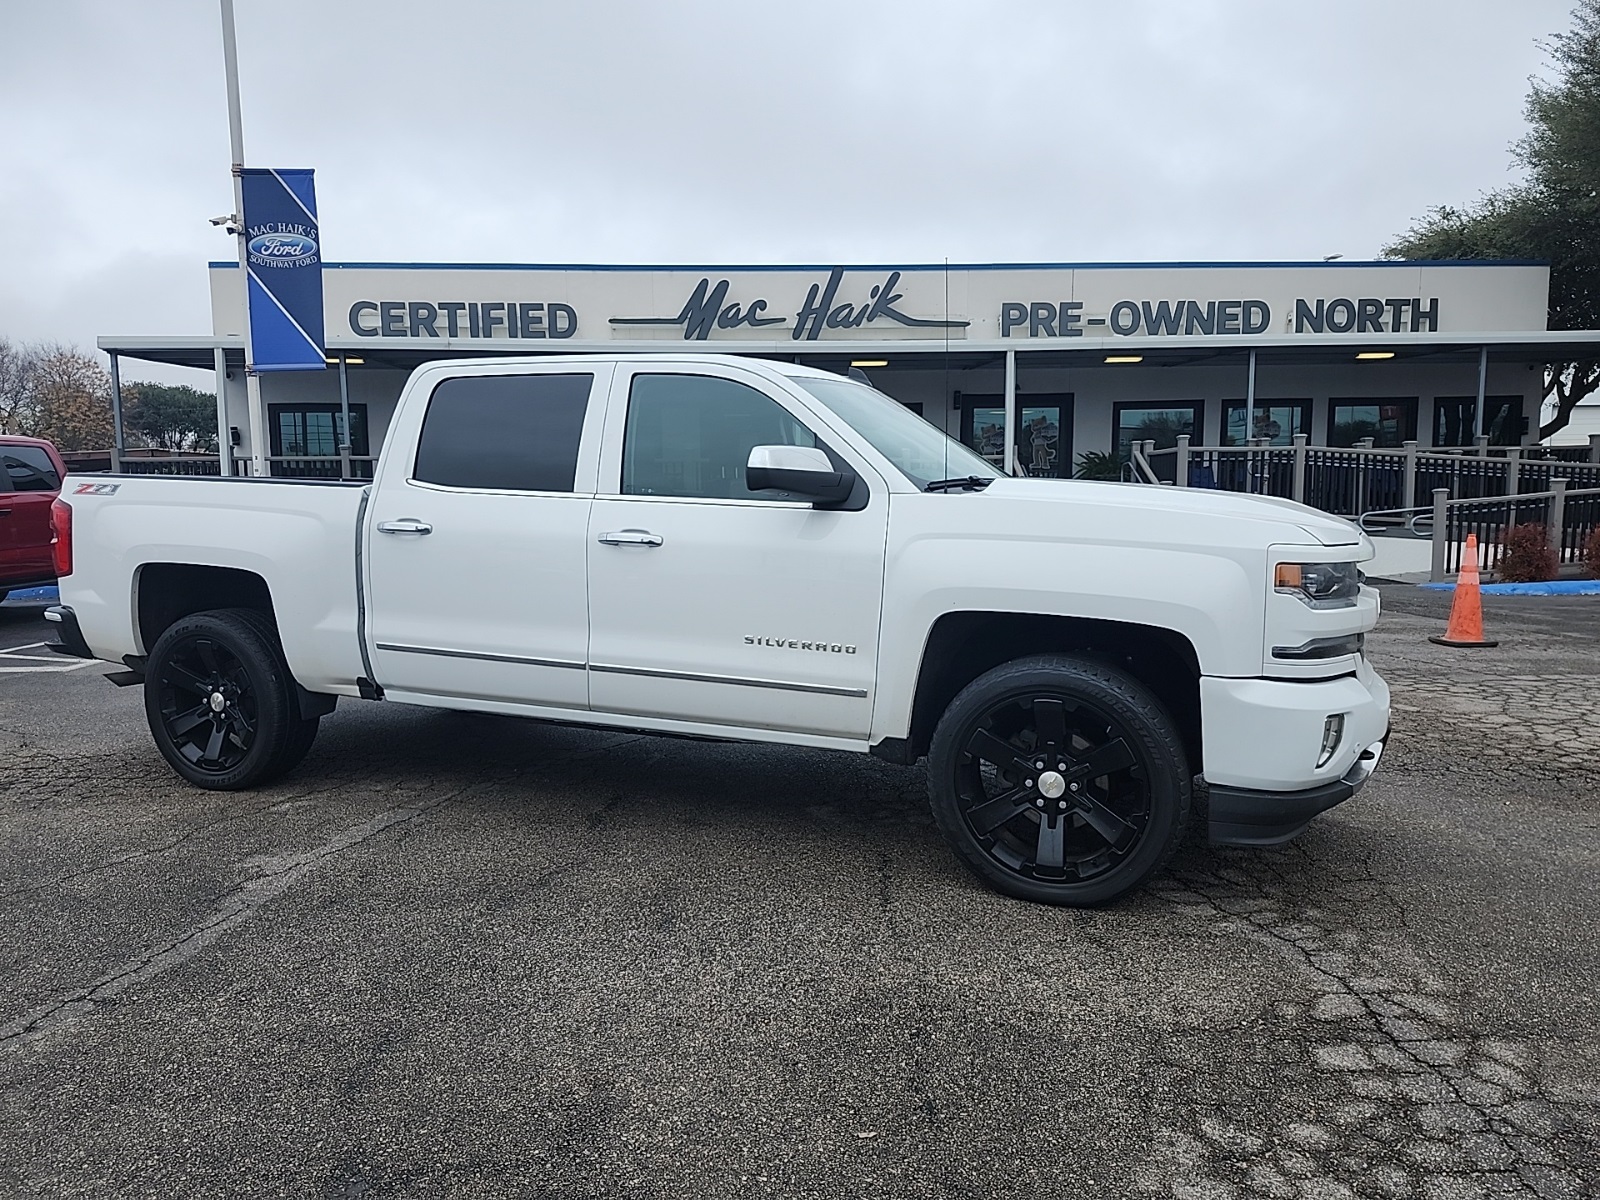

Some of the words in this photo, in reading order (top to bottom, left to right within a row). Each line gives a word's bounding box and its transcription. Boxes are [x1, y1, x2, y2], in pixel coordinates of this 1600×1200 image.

[248, 222, 275, 238] MAC
[277, 222, 317, 239] HAIK'S
[261, 237, 304, 255] Ford
[249, 254, 295, 269] SOUTHWAY
[295, 255, 318, 268] FORD
[608, 278, 787, 341] Mac
[792, 266, 971, 341] Haik
[349, 300, 578, 339] CERTIFIED
[1000, 300, 1271, 337] PRE-OWNED
[1294, 298, 1439, 333] NORTH
[72, 482, 121, 496] Z71
[744, 635, 857, 655] SILVERADO
